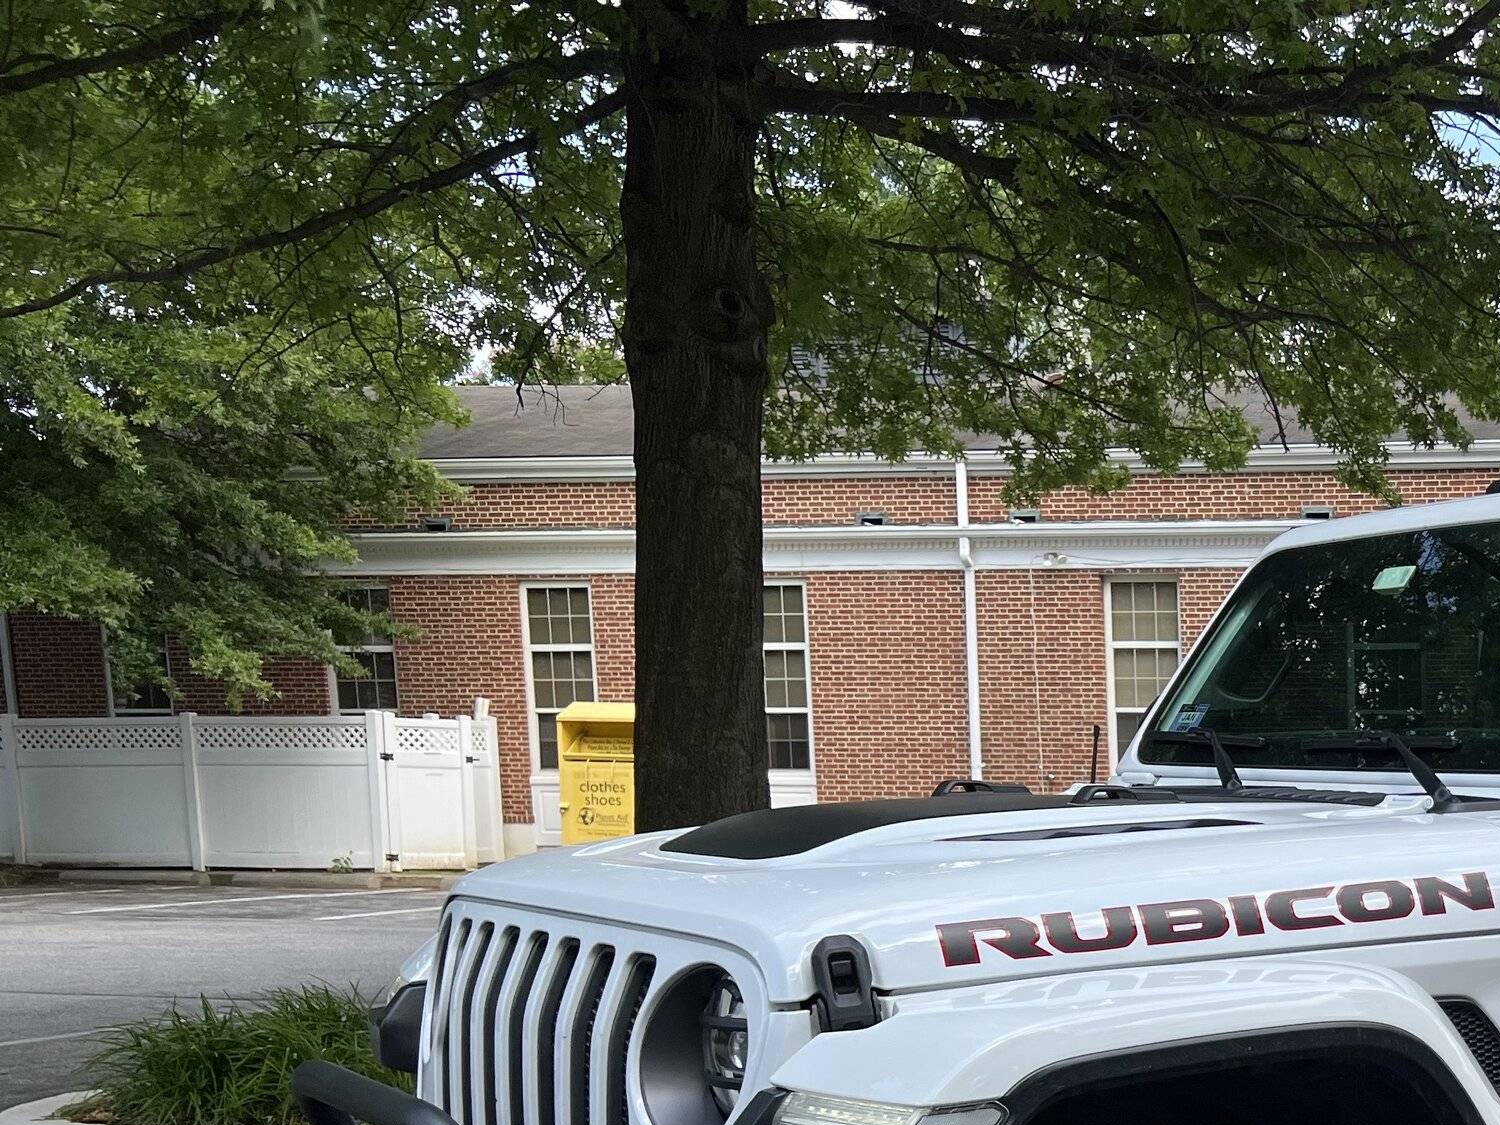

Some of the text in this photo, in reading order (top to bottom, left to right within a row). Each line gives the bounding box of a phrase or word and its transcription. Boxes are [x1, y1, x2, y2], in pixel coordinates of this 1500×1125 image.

[579, 781, 626, 793] clothes
[585, 793, 622, 806] shoes
[935, 871, 1495, 967] RUBICON
